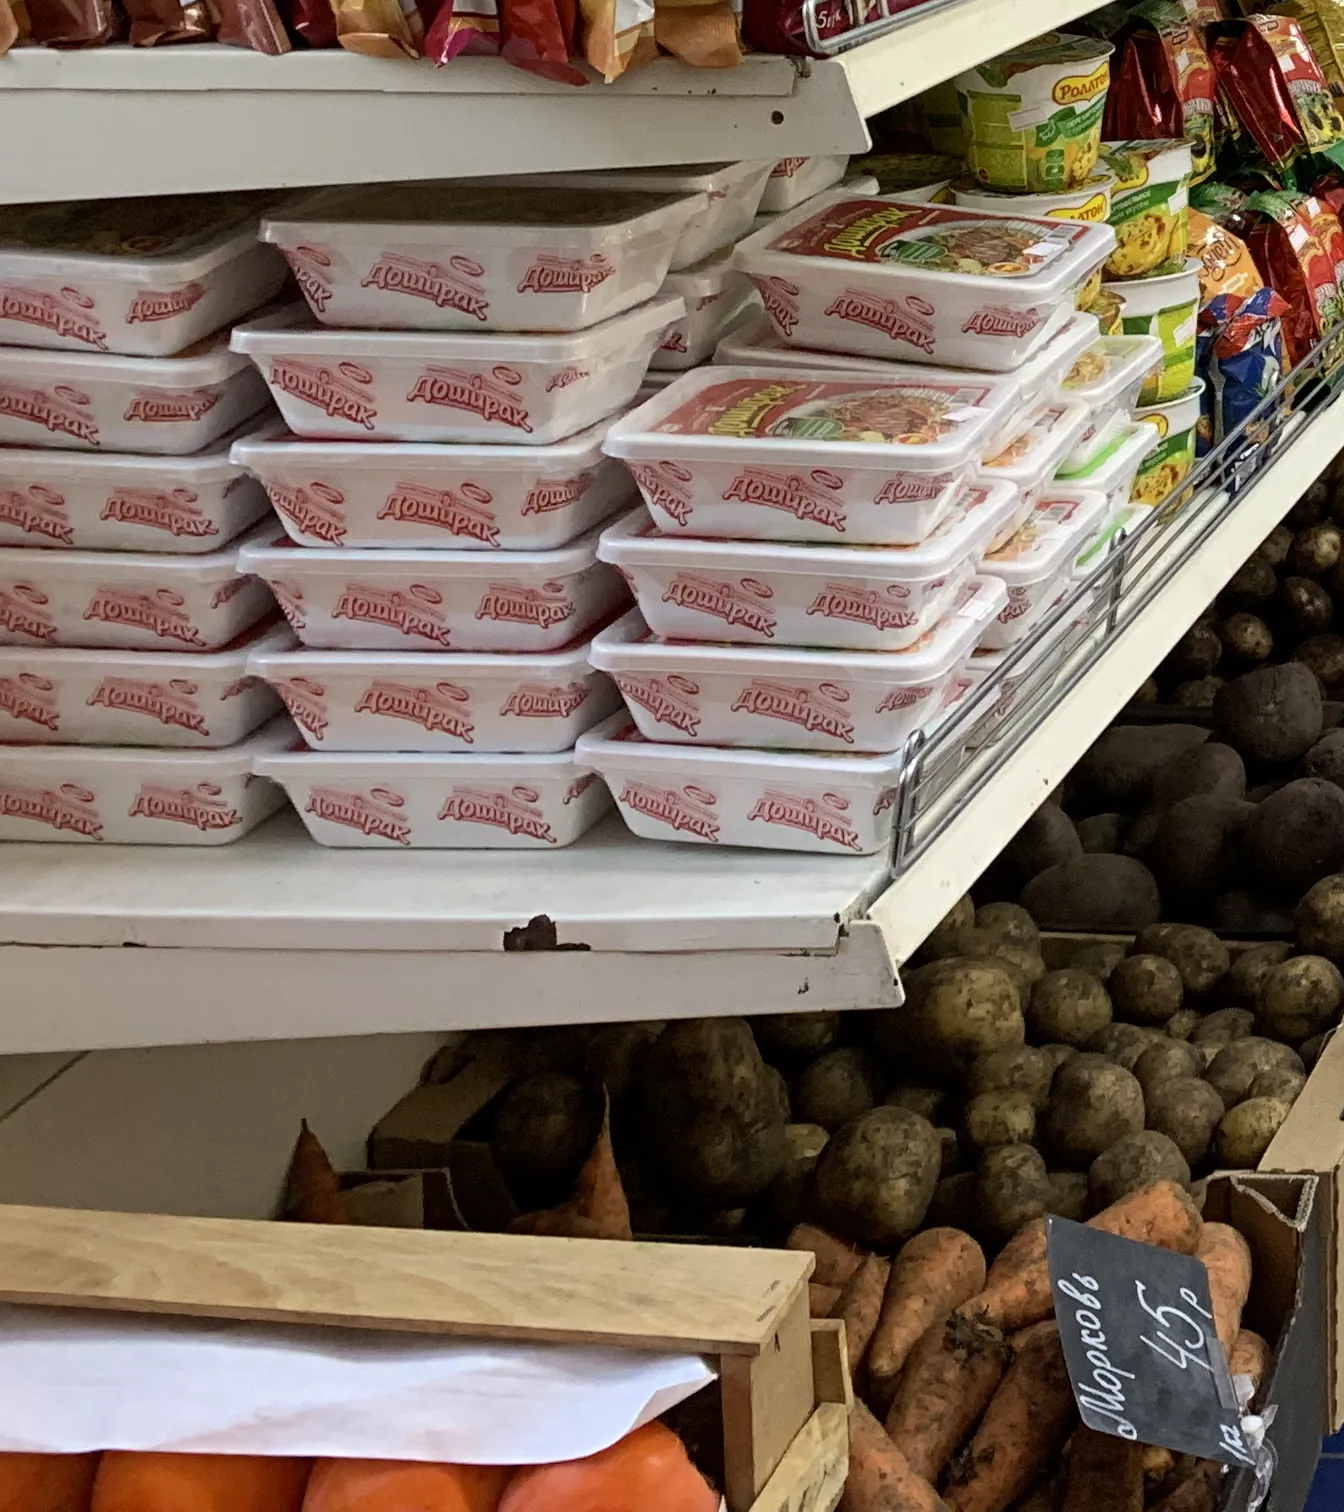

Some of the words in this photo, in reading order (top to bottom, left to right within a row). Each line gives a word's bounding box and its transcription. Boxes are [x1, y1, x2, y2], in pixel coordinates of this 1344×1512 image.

[361, 264, 490, 321] Доширак
[825, 293, 937, 356] Доширак
[962, 308, 1039, 338] Дошира
[124, 393, 220, 423] Дошира
[407, 374, 533, 433] Доширак
[100, 499, 221, 537] Доширак
[268, 488, 348, 548] оширак
[377, 494, 500, 548] Доширак
[723, 476, 848, 532] Доширак
[83, 600, 207, 647] Доширак
[331, 593, 451, 646] Доширак
[663, 580, 776, 638] Доширак
[806, 595, 919, 631] Доширак
[86, 685, 210, 737] Доширак
[354, 687, 475, 744] Доширак
[500, 690, 590, 719] Дошира
[731, 689, 856, 744] Доширак
[129, 795, 243, 831] Доширак
[305, 796, 412, 846] Доширак
[438, 796, 557, 844] Доширак
[619, 787, 721, 844] Доширак
[747, 796, 863, 852] Доширак
[1058, 1272, 1138, 1441] Морковь
